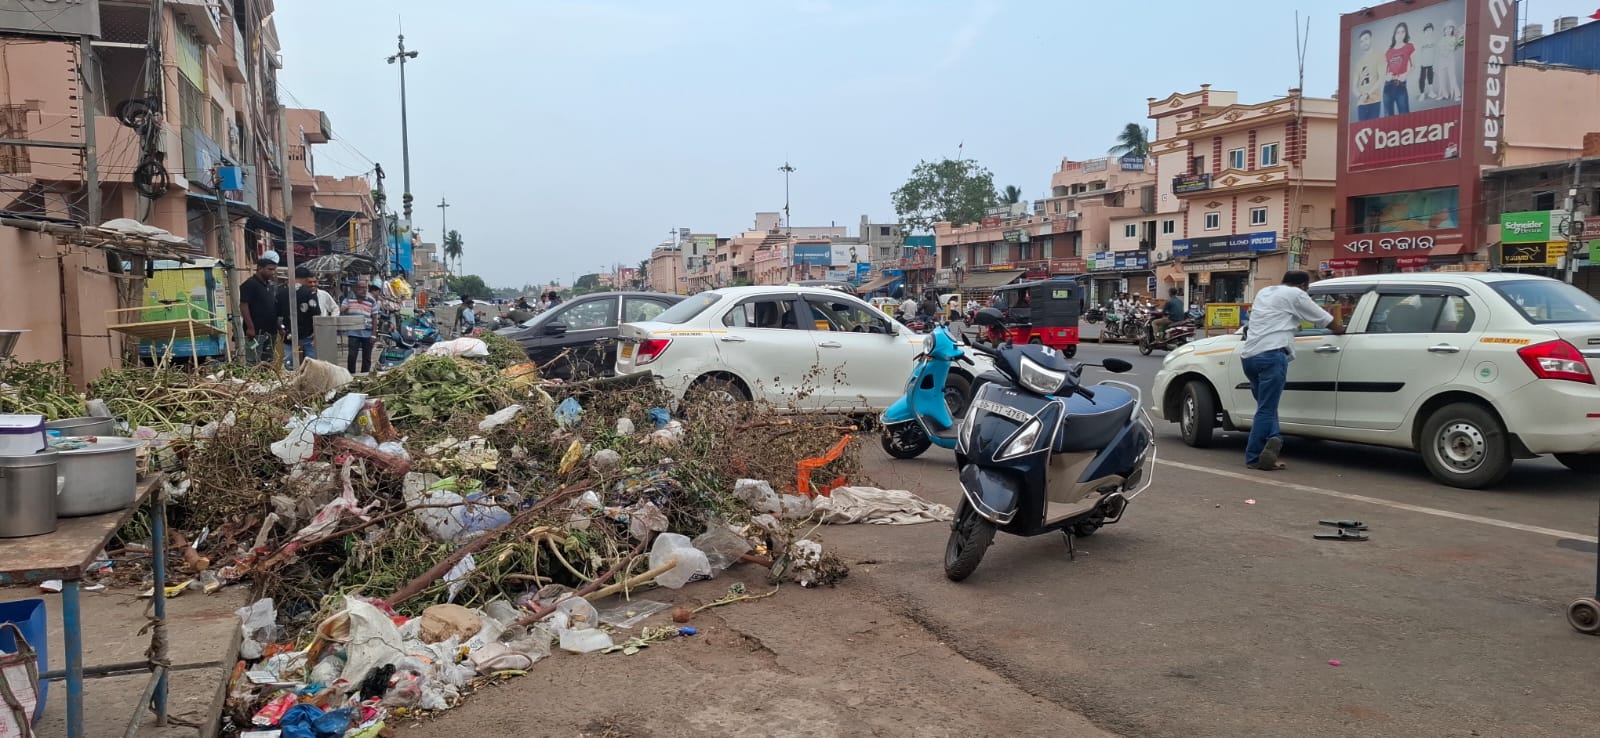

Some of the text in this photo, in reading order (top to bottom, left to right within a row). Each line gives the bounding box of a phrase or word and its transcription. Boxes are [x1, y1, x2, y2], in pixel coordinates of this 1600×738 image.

[1484, 34, 1510, 155] baazar
[1374, 121, 1456, 150] baazar
[1505, 220, 1543, 230] Schneider
[1379, 235, 1435, 251] ବଜାର
